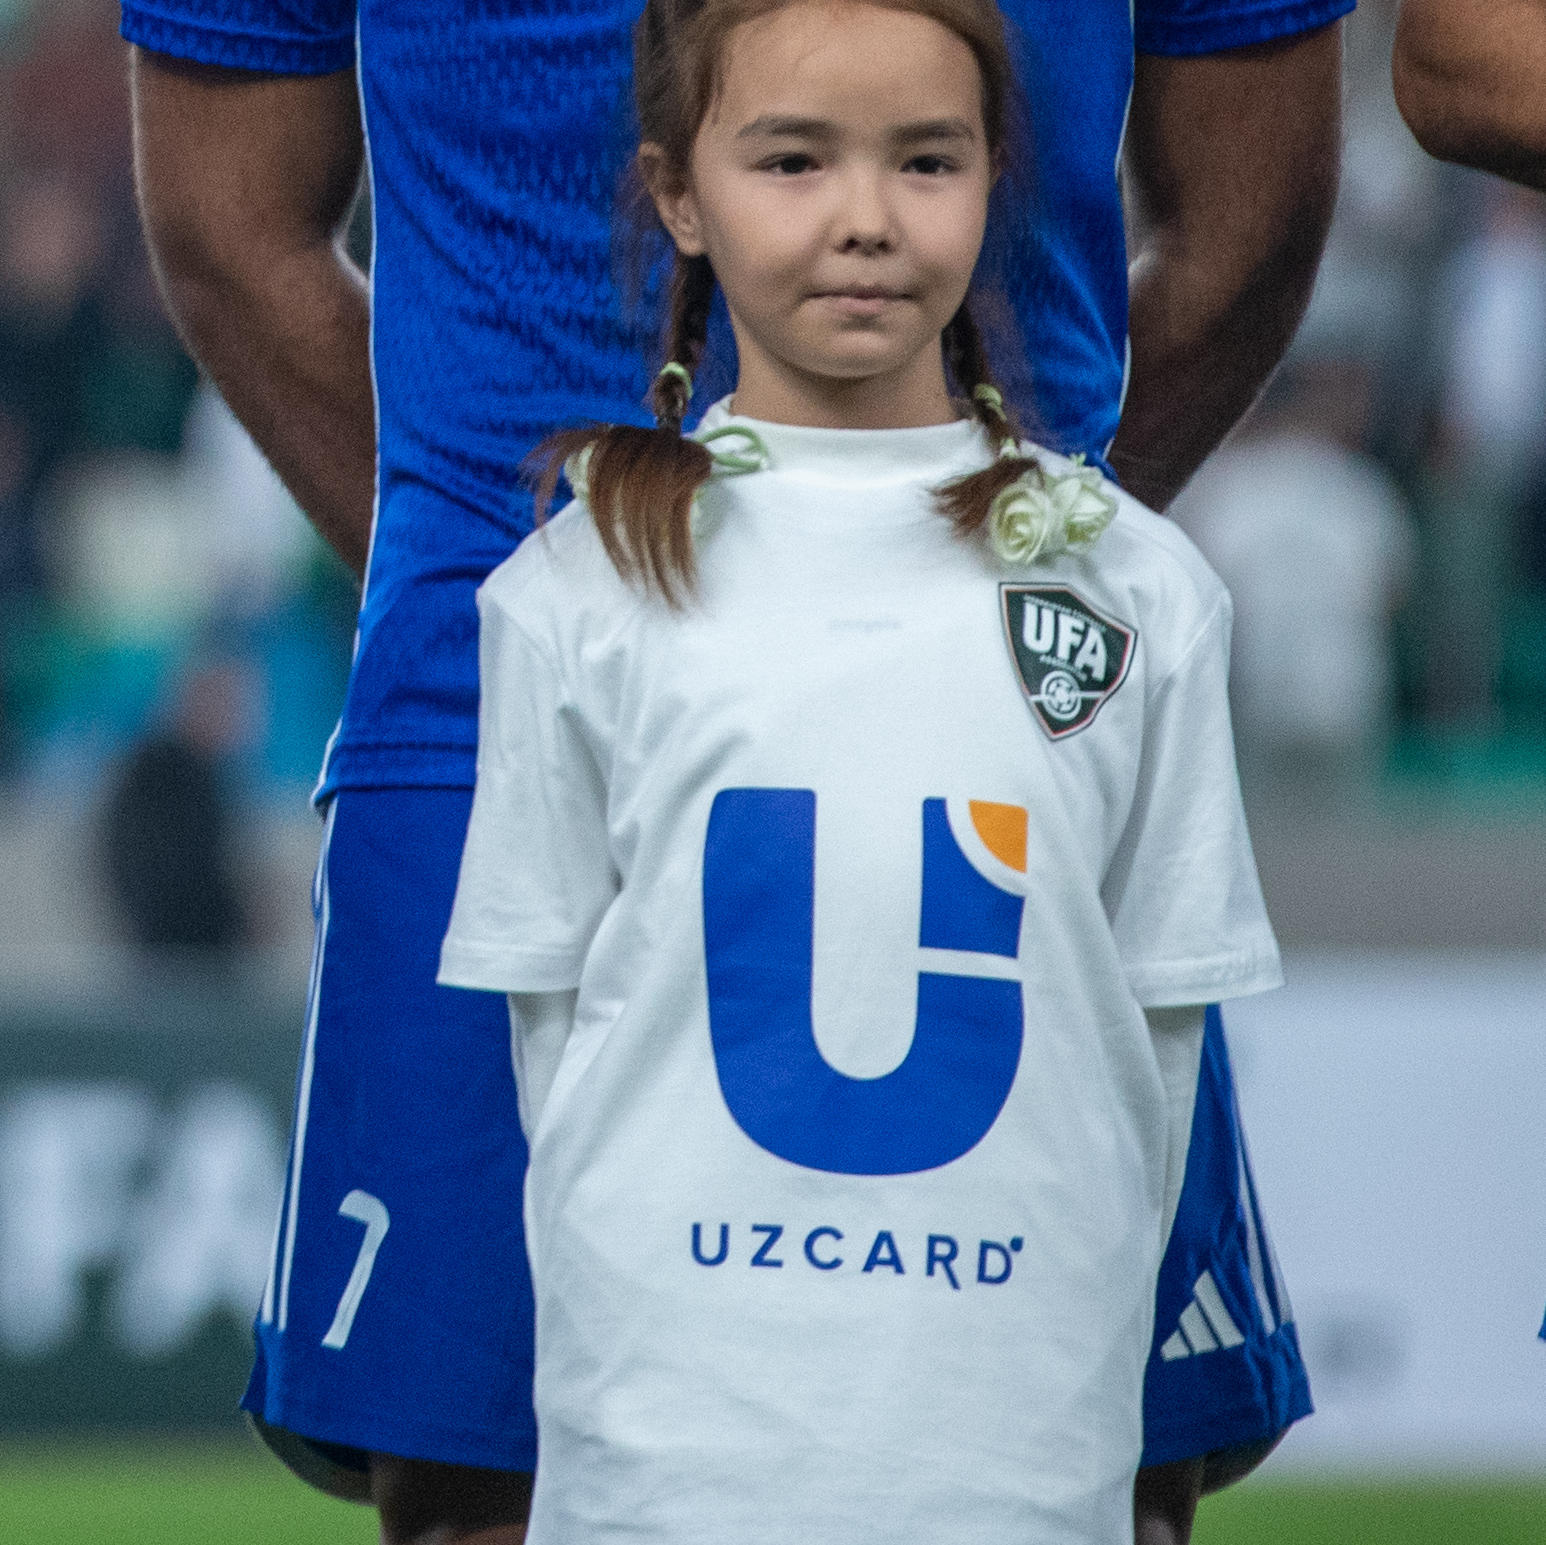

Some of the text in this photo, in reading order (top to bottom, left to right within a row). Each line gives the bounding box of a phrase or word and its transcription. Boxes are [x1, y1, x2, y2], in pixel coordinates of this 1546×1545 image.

[1022, 601, 1108, 683] UFA
[321, 1189, 390, 1351] 7
[690, 1221, 1024, 1290] UZCARD
